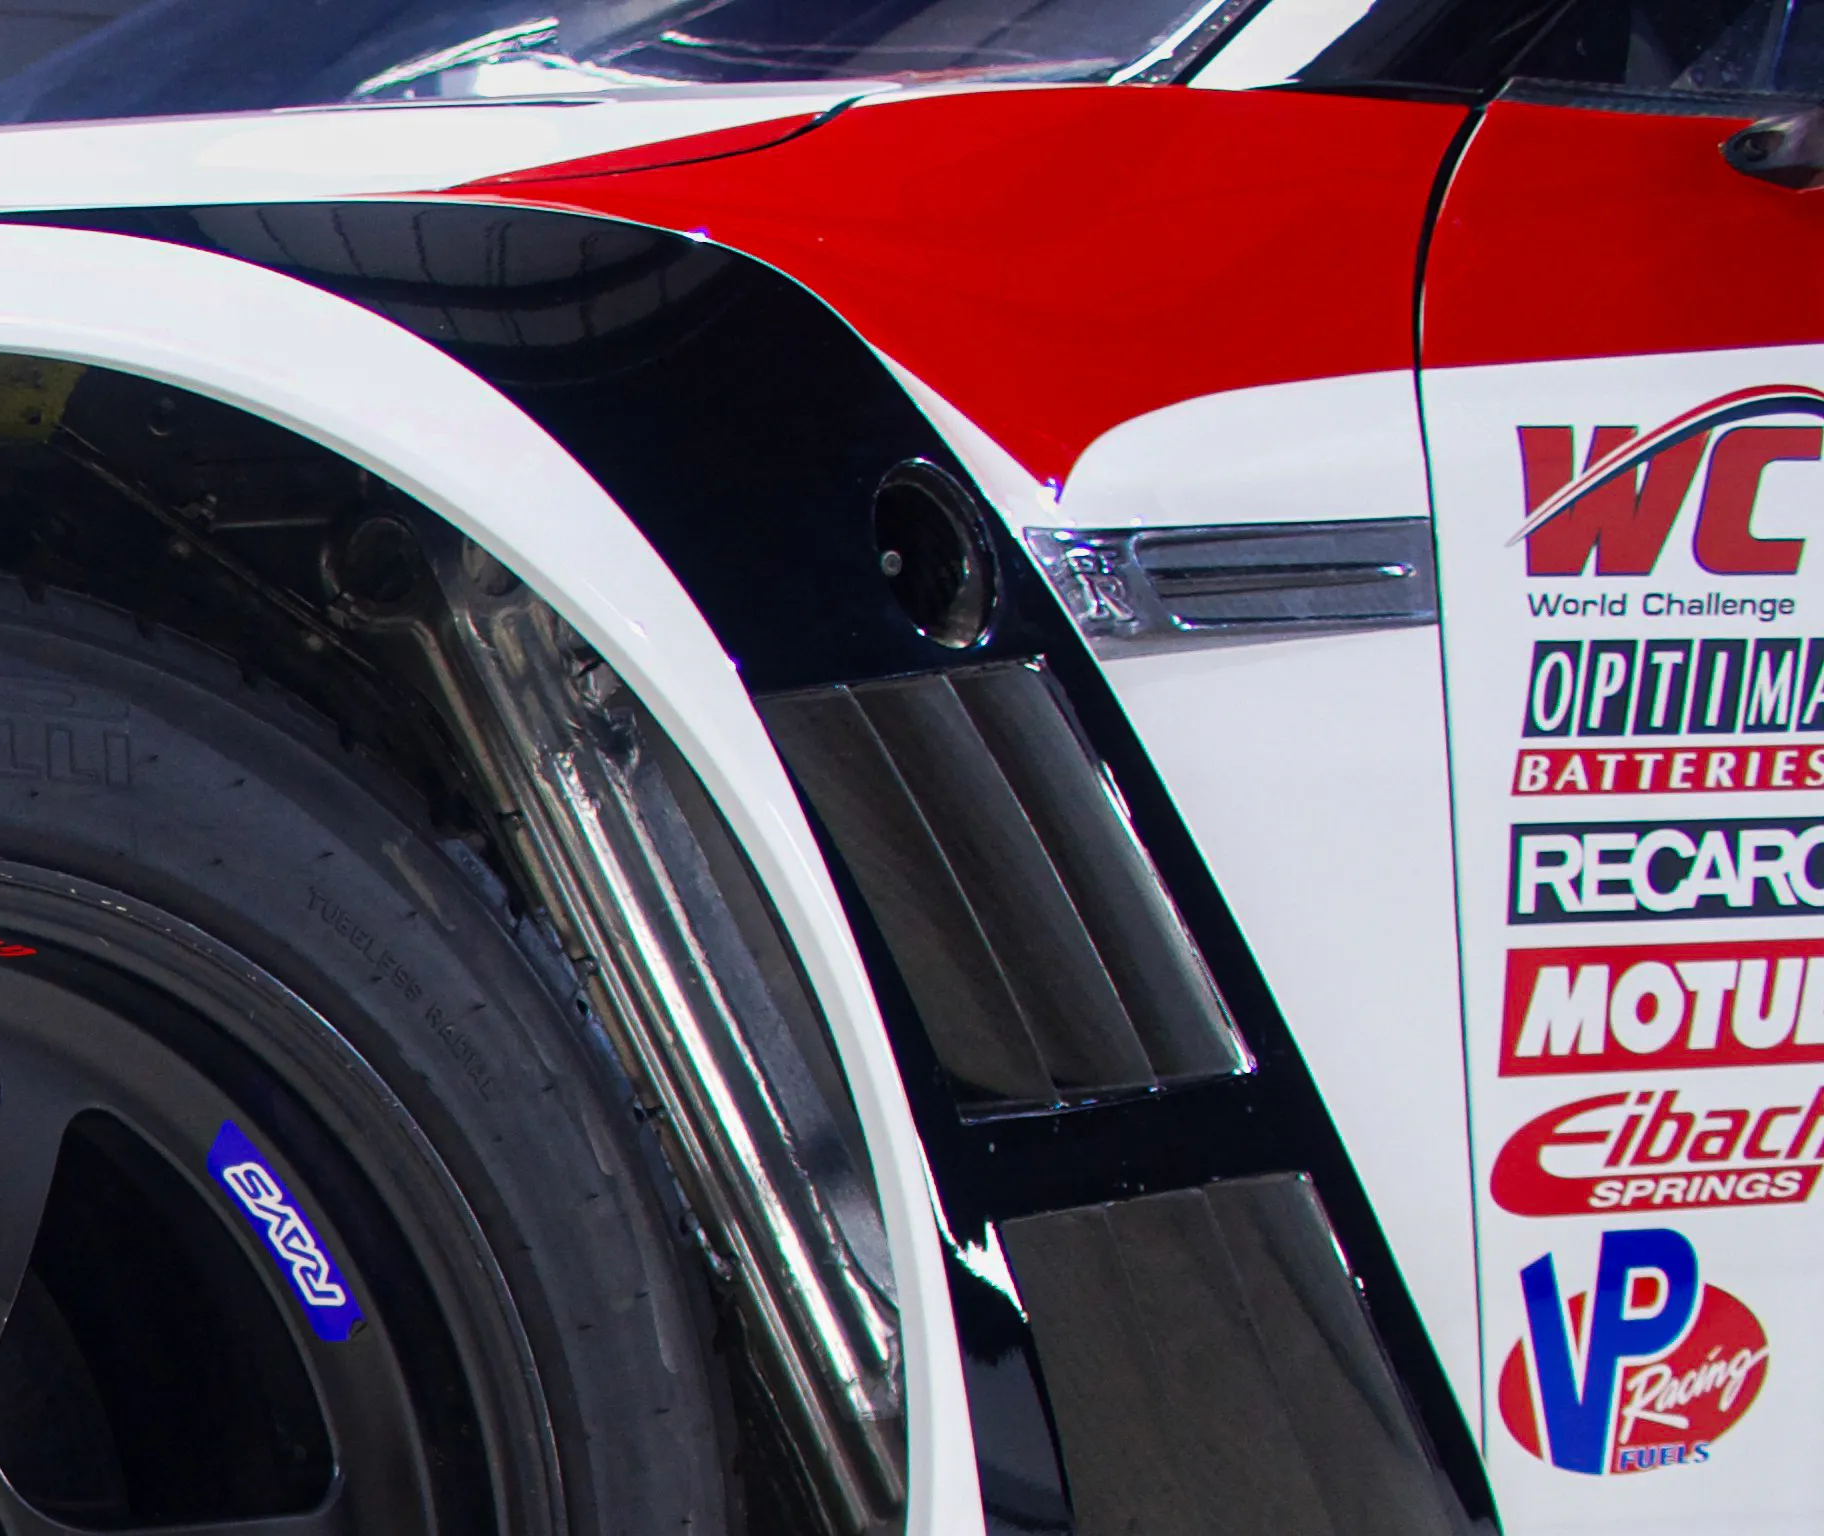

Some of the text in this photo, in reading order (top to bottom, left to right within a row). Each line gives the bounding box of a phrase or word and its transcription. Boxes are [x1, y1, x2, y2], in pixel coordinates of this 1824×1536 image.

[1516, 424, 1824, 577] WC
[1527, 592, 1796, 621] World Challenge
[223, 1162, 346, 1307] RAYS
[1587, 1170, 1802, 1208] SPRINGS
[1519, 1228, 1699, 1476] VP
[1618, 1344, 1770, 1444] Racing
[1617, 1442, 1711, 1472] FUELS
